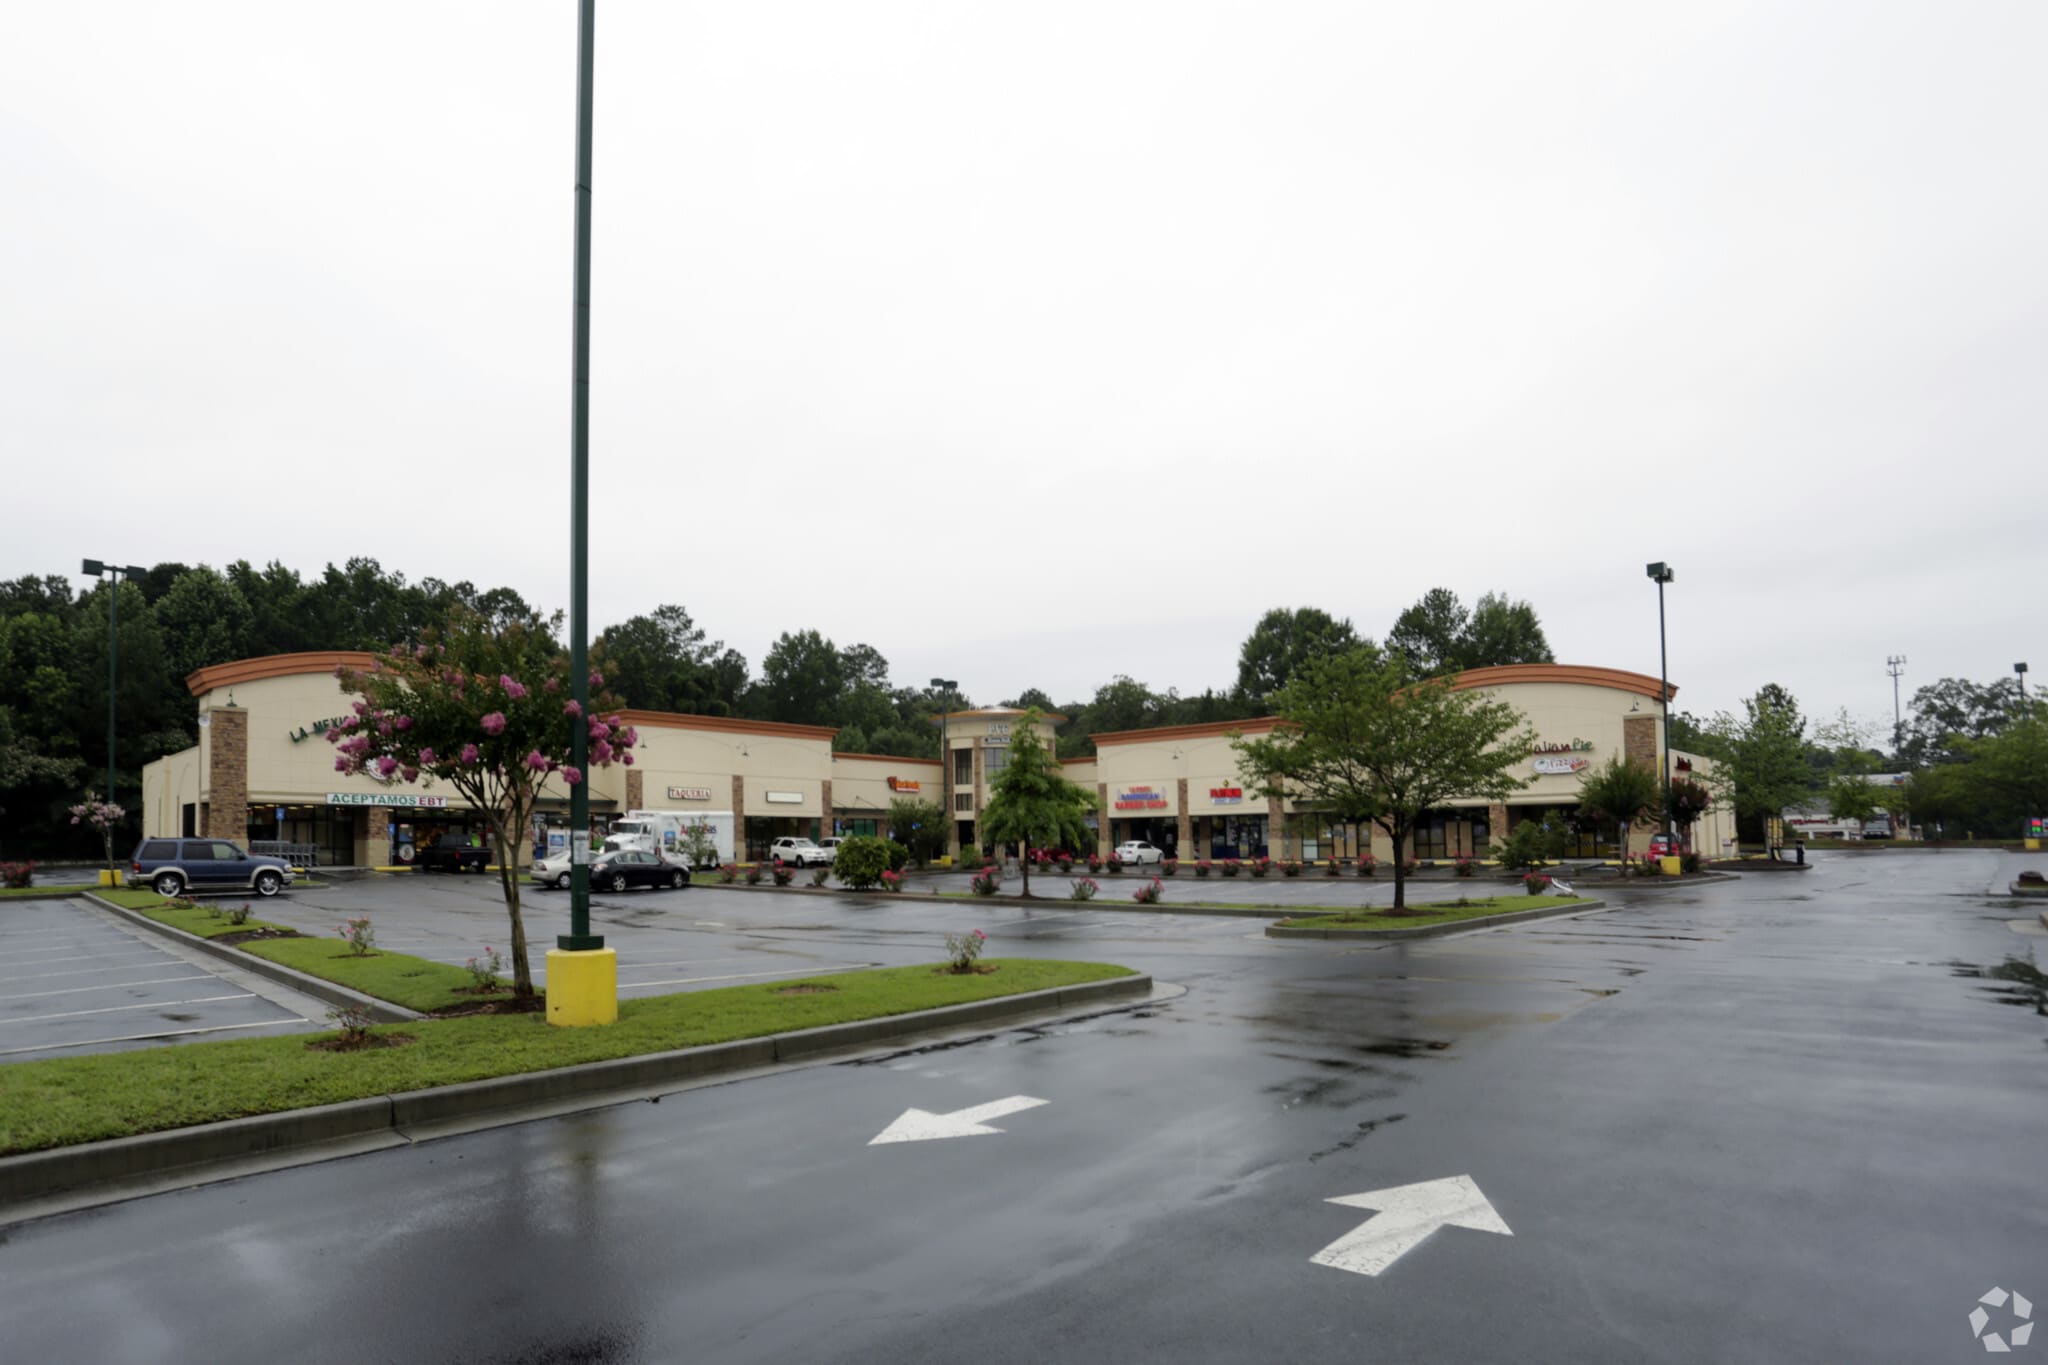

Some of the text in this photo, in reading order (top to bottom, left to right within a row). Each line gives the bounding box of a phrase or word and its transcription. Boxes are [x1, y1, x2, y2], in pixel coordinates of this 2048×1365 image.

[289, 727, 308, 743] LA
[1572, 737, 1594, 752] Pie
[331, 794, 444, 806] ACEPTAMOS EBT
[671, 788, 710, 799] TAQUERIA
